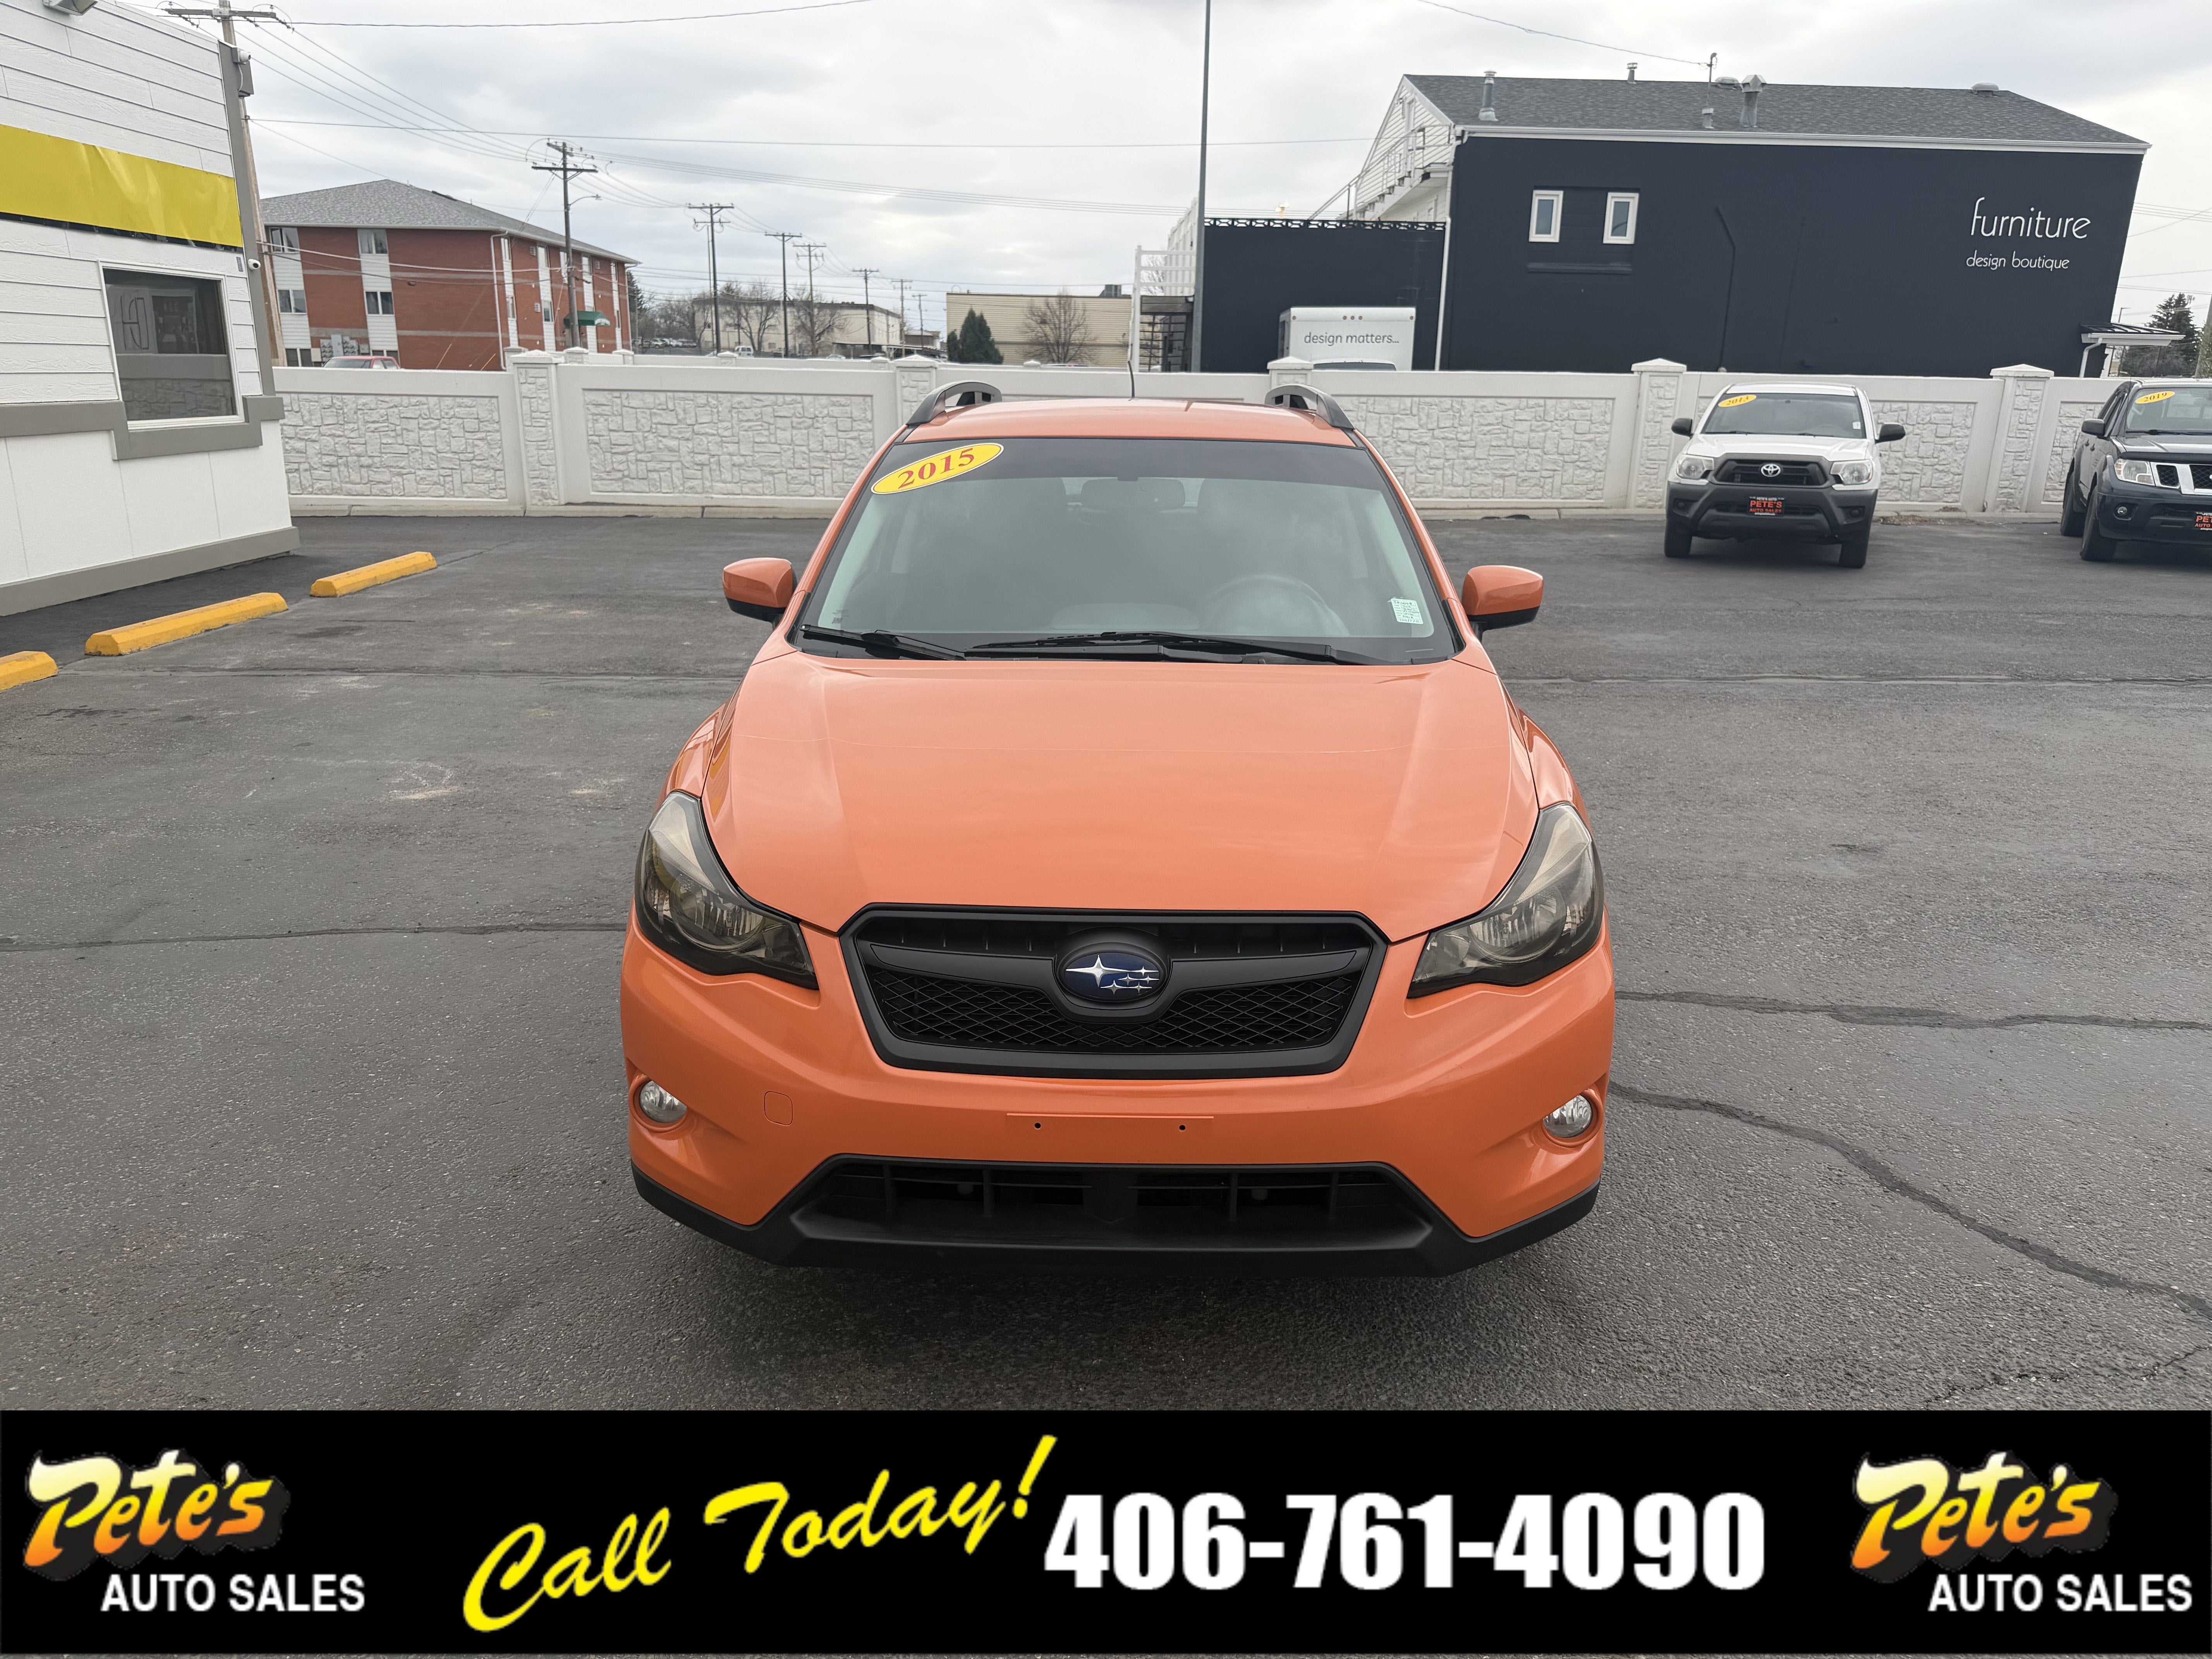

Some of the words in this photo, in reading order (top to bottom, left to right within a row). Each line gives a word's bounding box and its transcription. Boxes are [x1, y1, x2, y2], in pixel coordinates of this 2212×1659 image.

[1971, 197, 2091, 239] furniture
[1966, 250, 2006, 270] design
[2012, 251, 2070, 271] boutique
[1304, 332, 1342, 346] design
[1346, 334, 1400, 344] matters...
[2144, 392, 2167, 402] 2019
[898, 447, 975, 489] 2015
